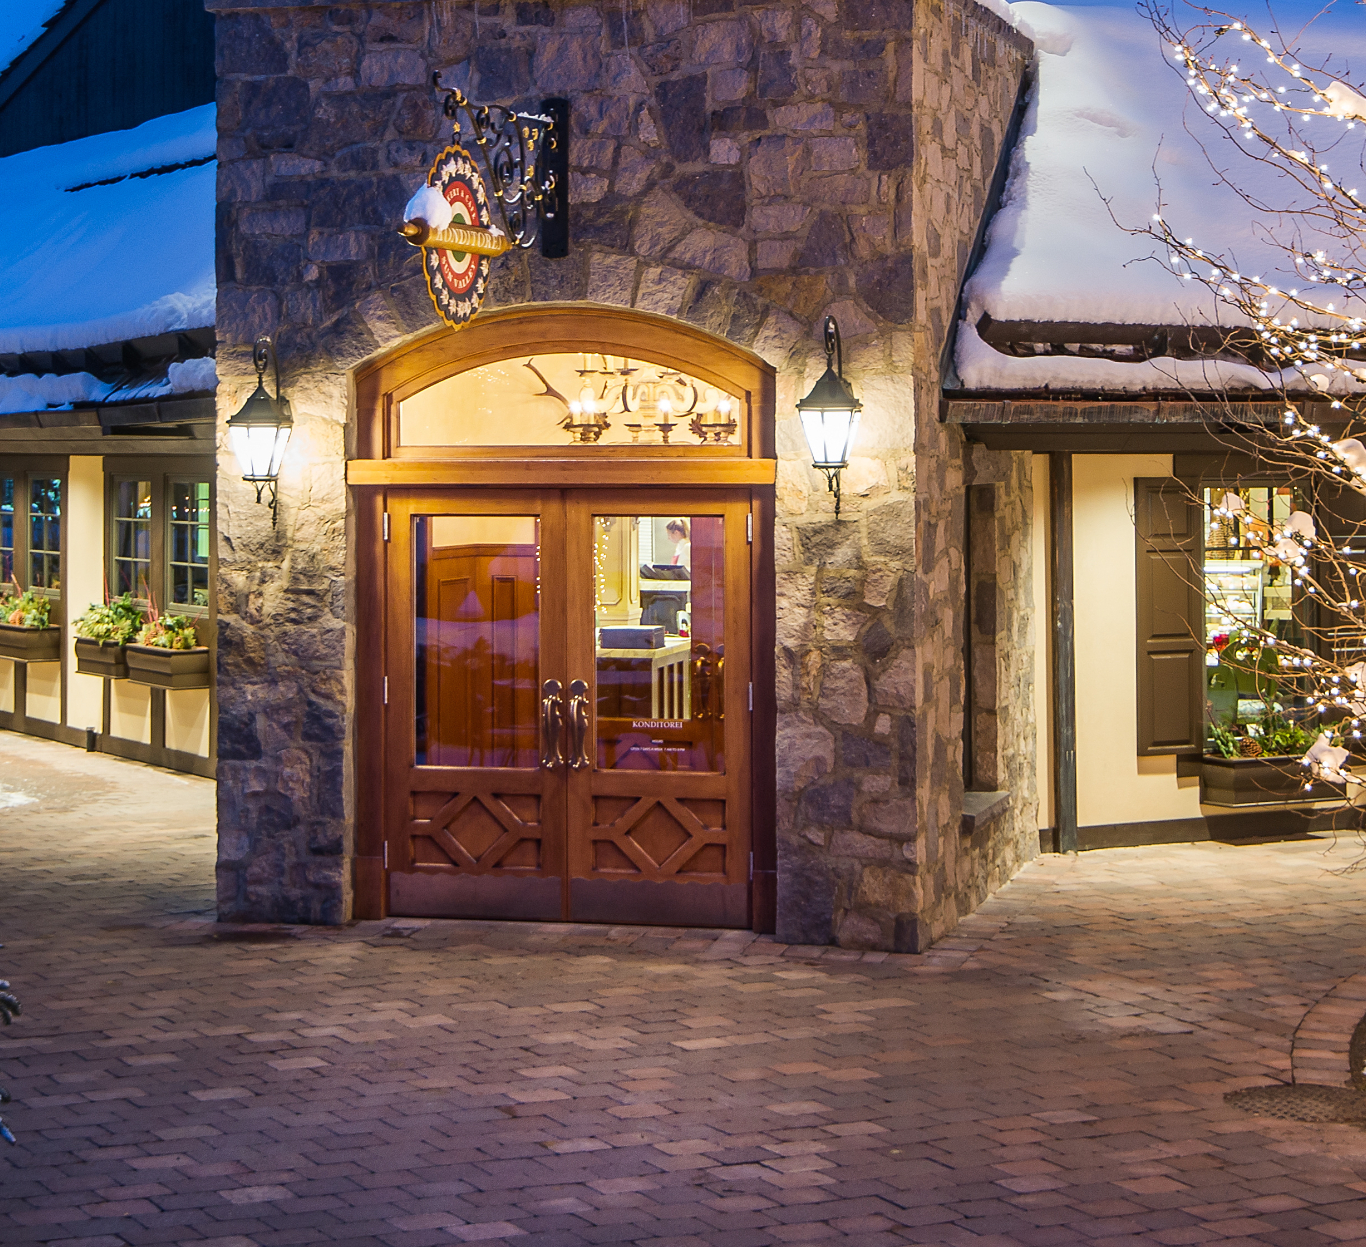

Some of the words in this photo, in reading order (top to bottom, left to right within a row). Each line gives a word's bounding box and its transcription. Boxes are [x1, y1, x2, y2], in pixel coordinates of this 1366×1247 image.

[435, 227, 502, 250] KONDITOREI
[441, 255, 454, 283] SUN
[453, 260, 476, 289] VALLEY
[632, 721, 683, 729] KONDITOREI
